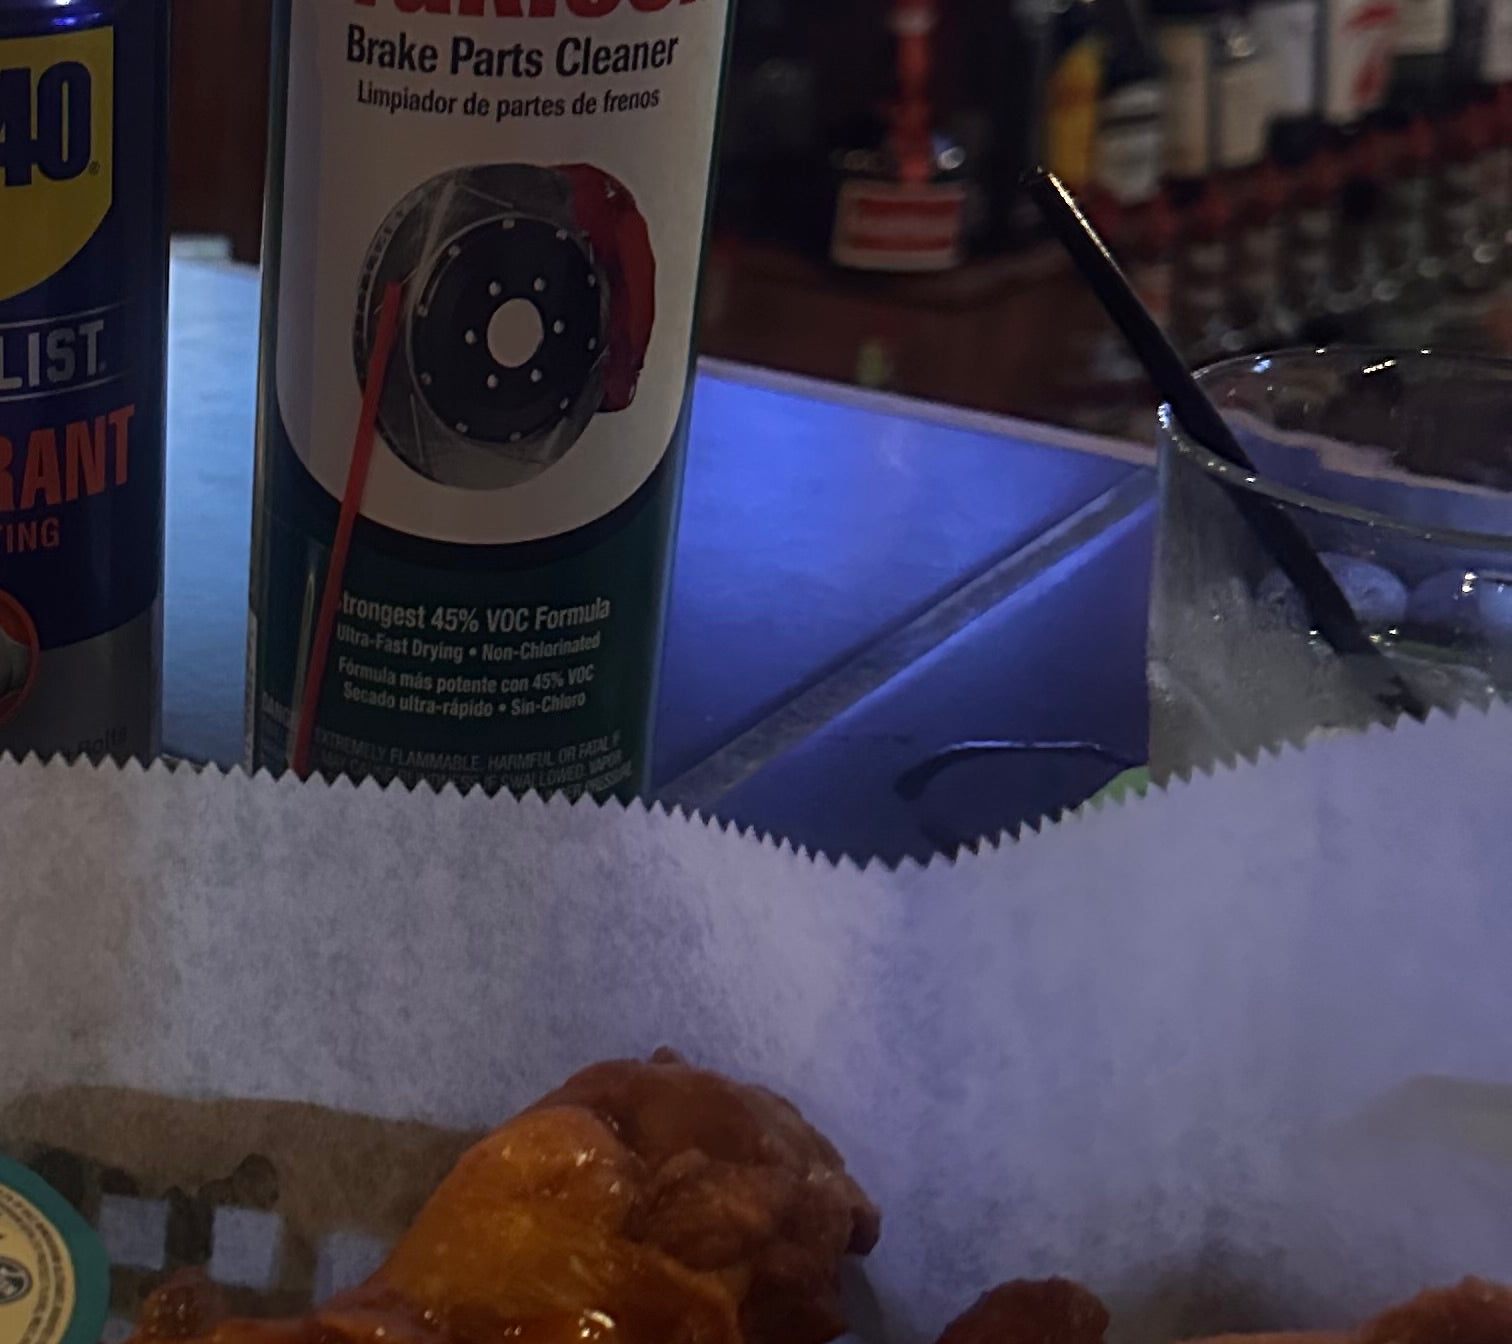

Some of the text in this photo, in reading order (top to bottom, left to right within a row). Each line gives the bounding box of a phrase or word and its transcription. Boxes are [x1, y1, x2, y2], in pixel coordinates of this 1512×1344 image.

[346, 24, 678, 77] Brake Parts Cleaner
[358, 81, 659, 122] Limpiador de partes de frenos
[340, 590, 611, 633] trongest 45% VOC Formula
[338, 622, 601, 664] Ultra-Fast Drying Non-Chlorinated
[344, 681, 395, 708] Secado
[511, 692, 586, 716] Sin-Chloro
[400, 670, 433, 692] más
[437, 675, 497, 695] potente
[500, 676, 529, 693] con
[532, 671, 564, 689] 45%
[568, 664, 595, 683] VOC
